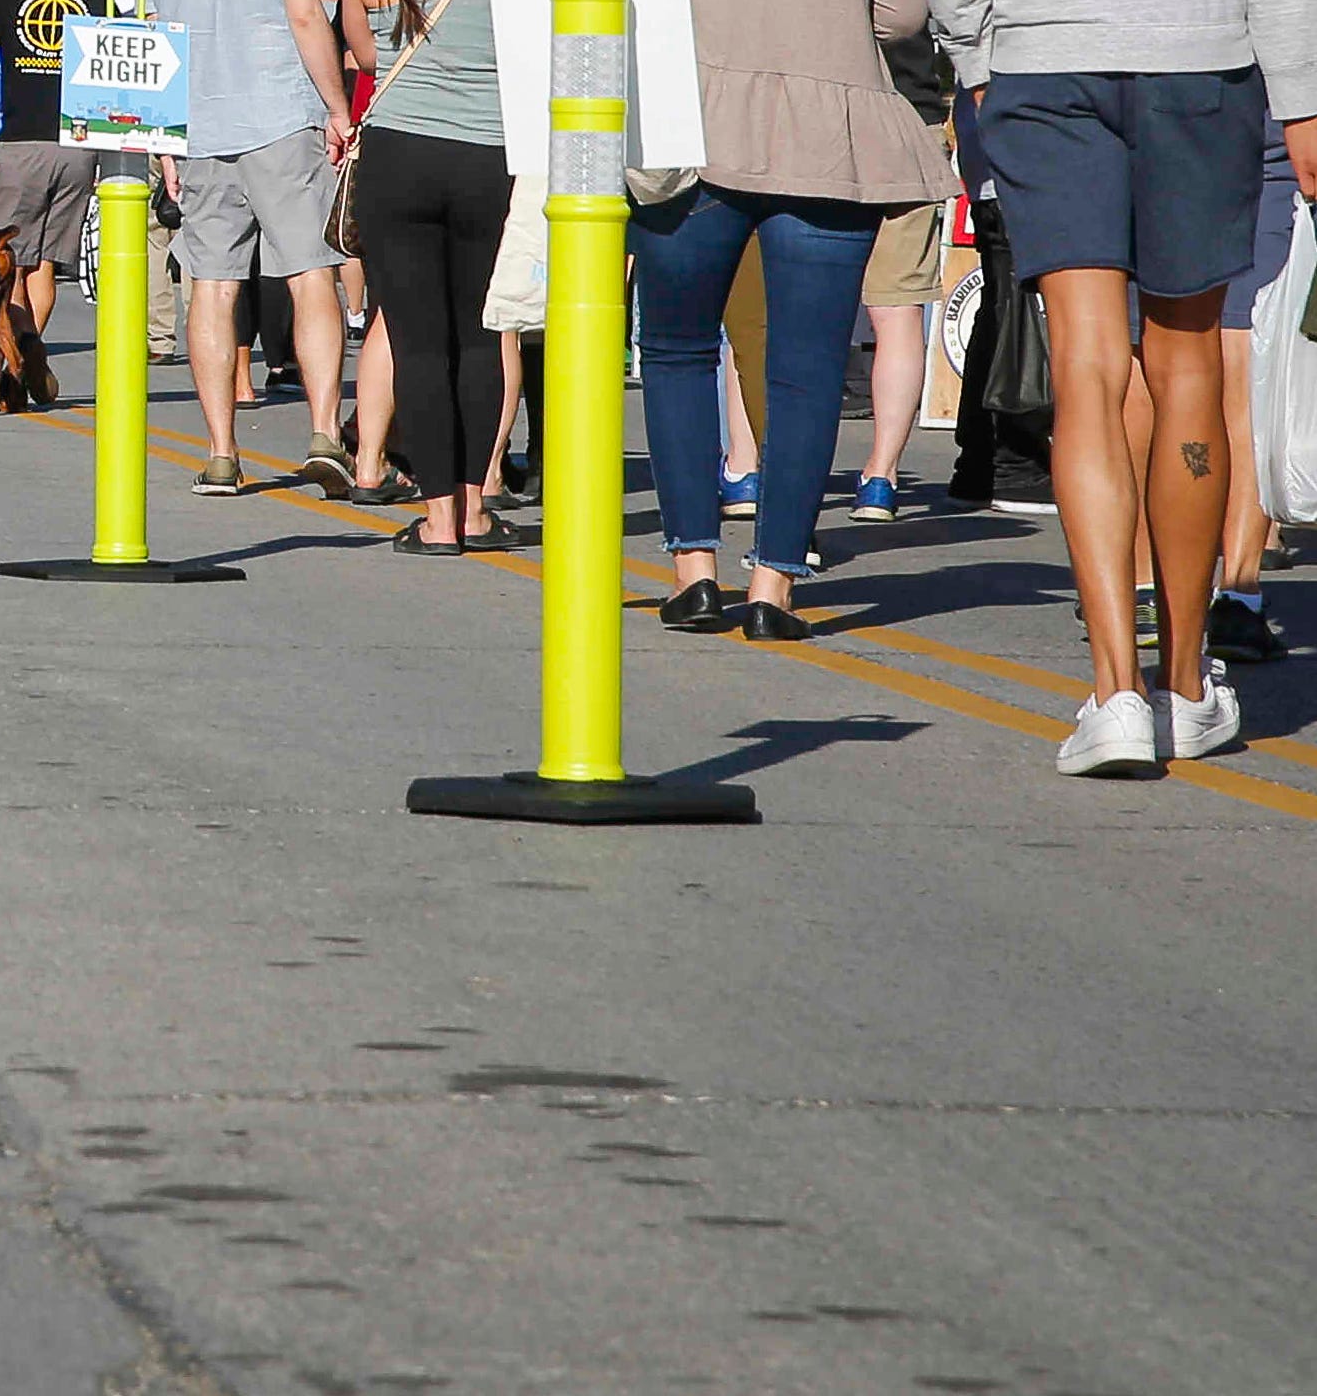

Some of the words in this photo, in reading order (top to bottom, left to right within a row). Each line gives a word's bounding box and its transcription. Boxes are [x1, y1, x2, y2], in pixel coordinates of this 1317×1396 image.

[96, 34, 156, 60] KEEP
[90, 58, 162, 85] RIGHT
[946, 274, 981, 321] BEARDED
